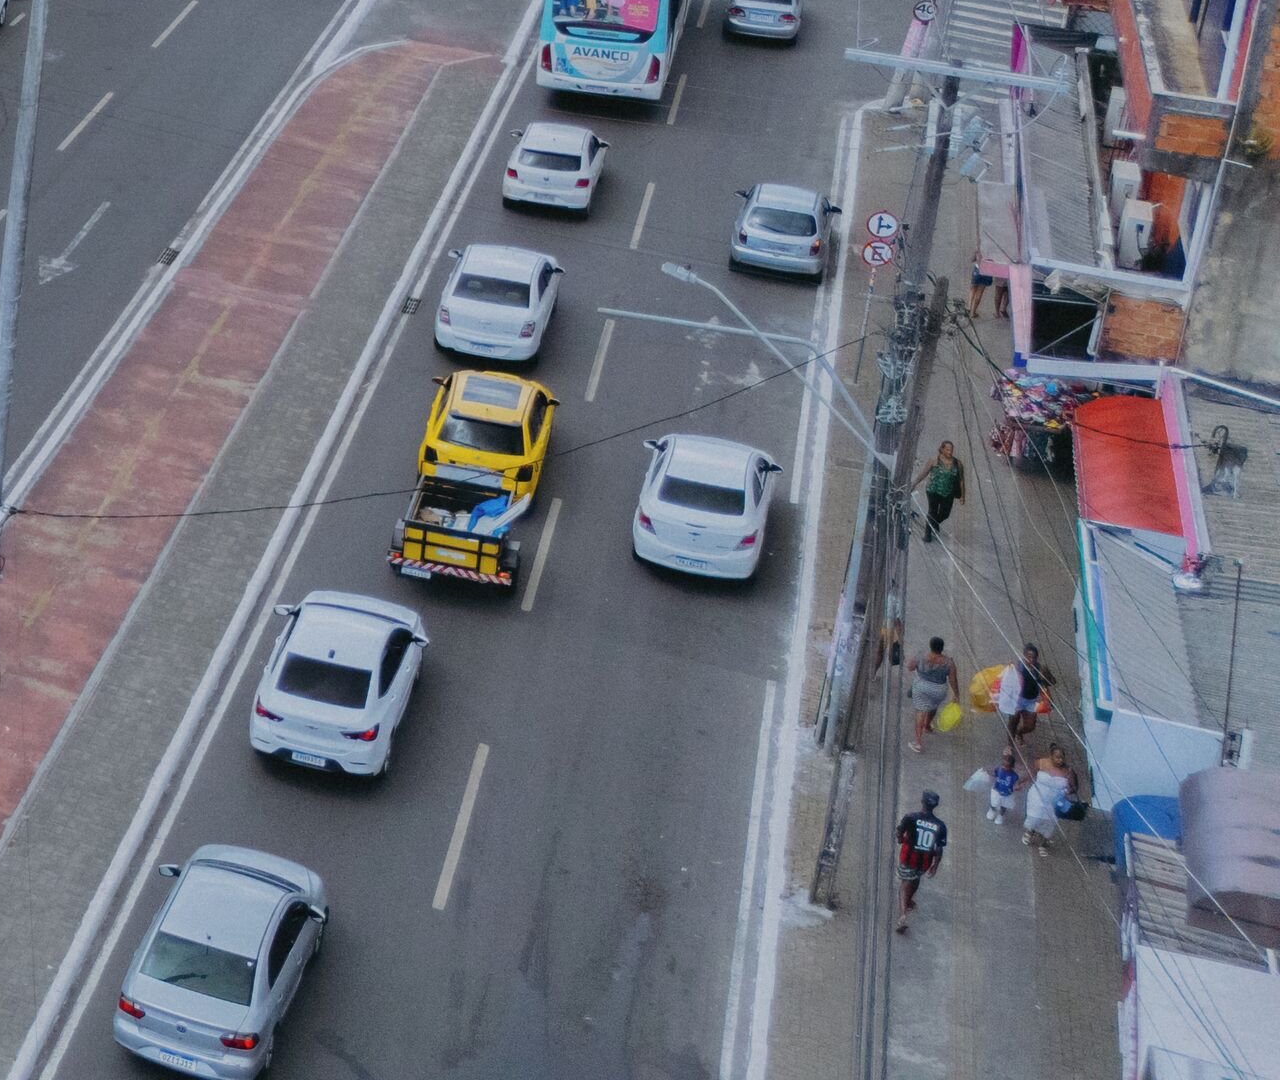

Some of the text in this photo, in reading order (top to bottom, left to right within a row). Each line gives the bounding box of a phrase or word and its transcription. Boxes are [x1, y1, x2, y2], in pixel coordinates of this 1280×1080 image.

[572, 46, 630, 64] AVANÇO
[916, 819, 938, 832] CAIXA
[916, 828, 935, 848] 10
